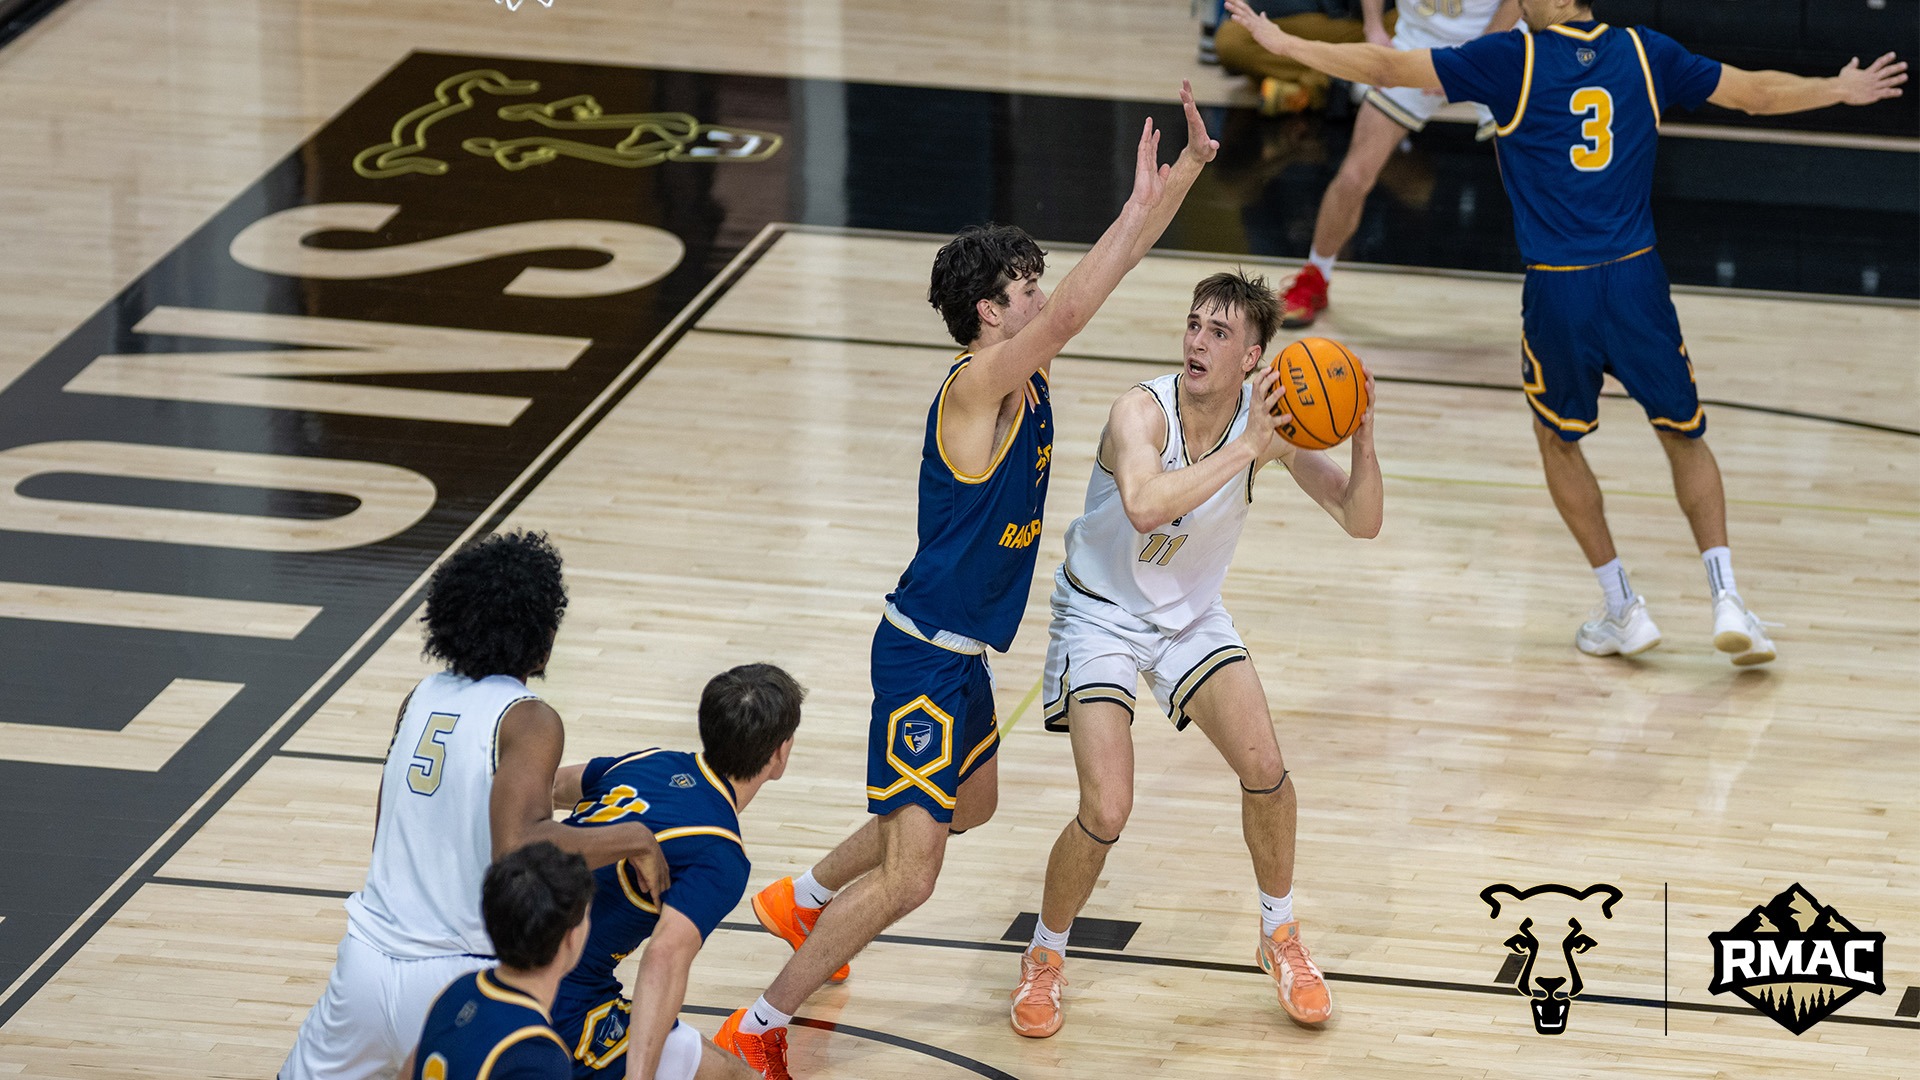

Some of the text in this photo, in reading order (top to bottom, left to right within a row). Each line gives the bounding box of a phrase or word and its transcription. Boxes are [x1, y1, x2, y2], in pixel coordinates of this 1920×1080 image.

[1570, 86, 1613, 172] 3
[1138, 533, 1188, 566] 11
[406, 711, 460, 797] 5
